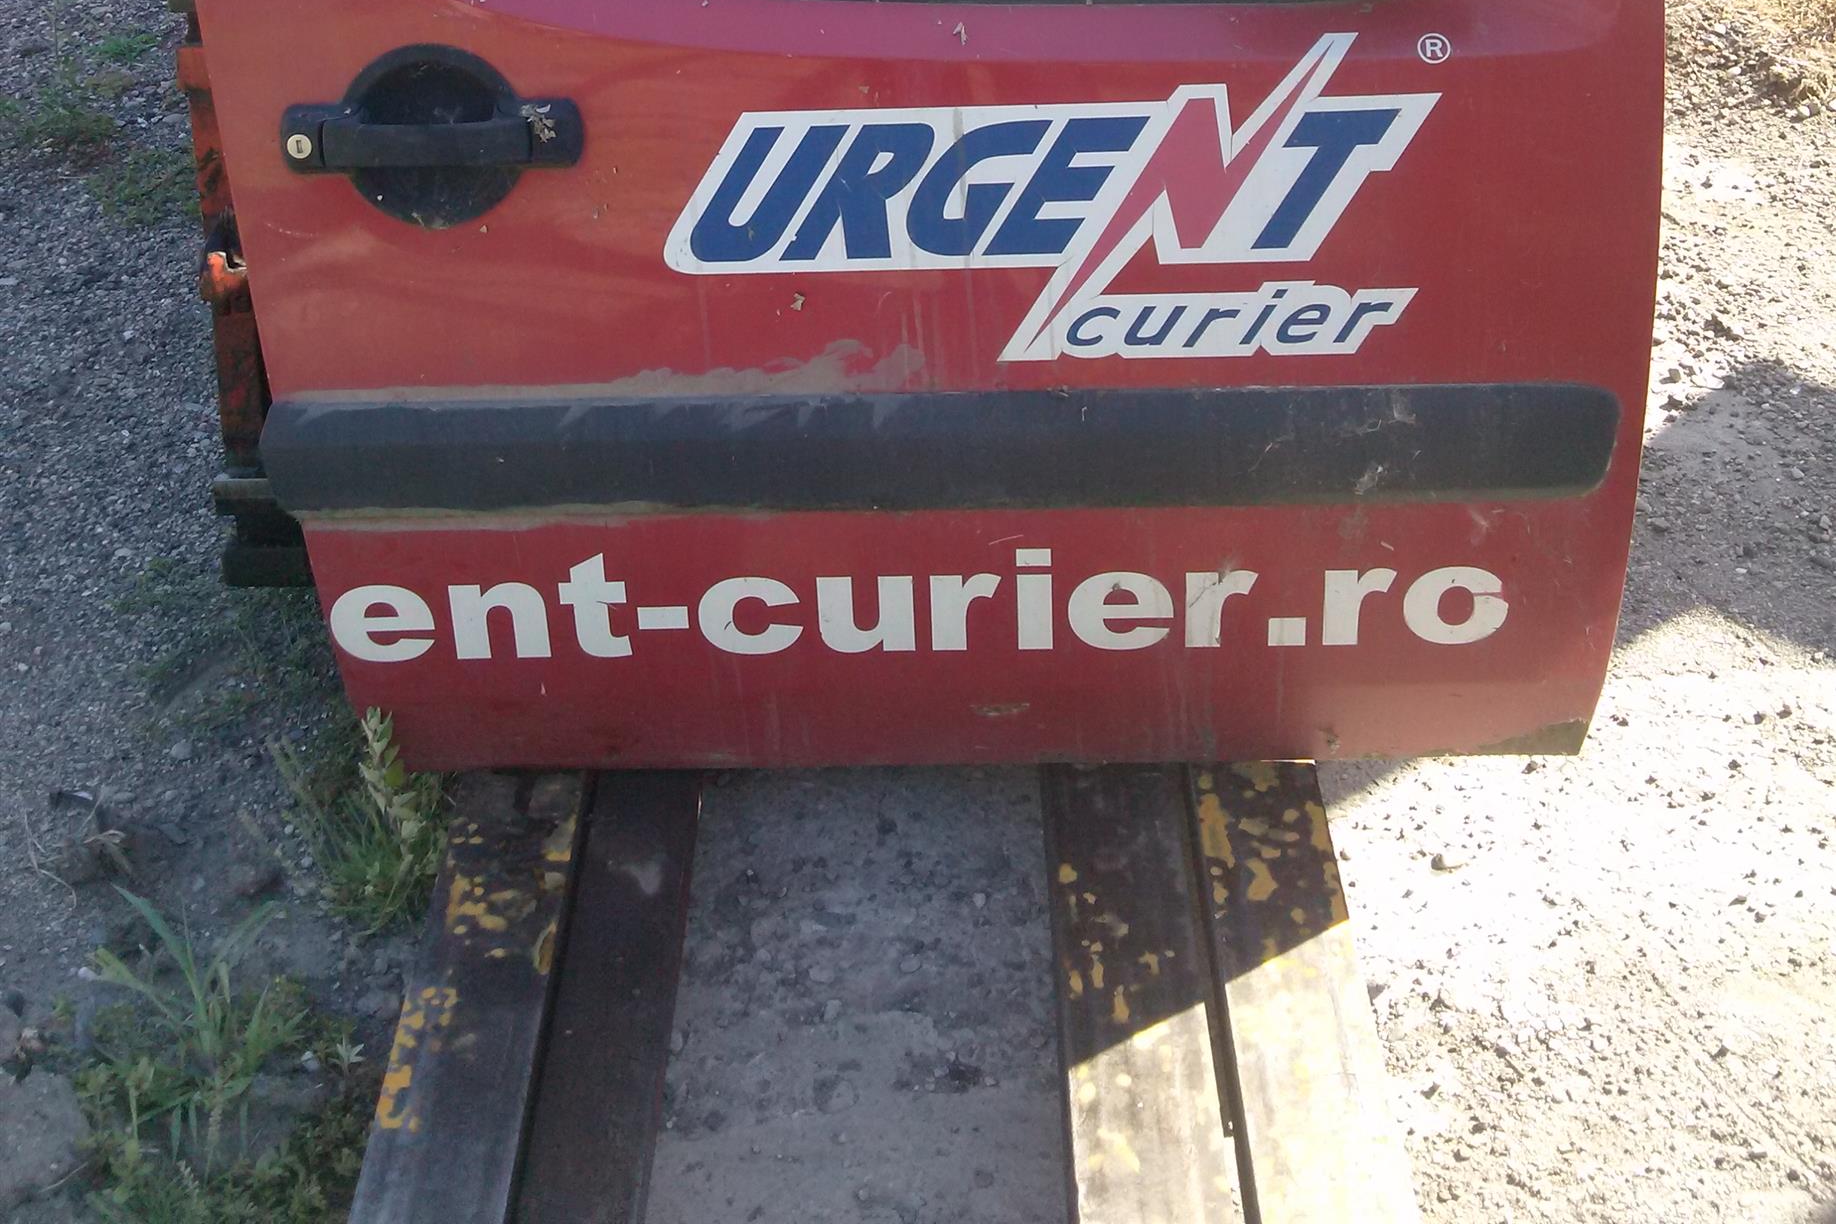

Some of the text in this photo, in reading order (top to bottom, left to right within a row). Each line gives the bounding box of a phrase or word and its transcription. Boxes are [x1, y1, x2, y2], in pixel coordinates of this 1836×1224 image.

[680, 39, 1415, 276] URGENT
[1066, 288, 1395, 349] curier
[330, 548, 1510, 663] ent-curier.ro
